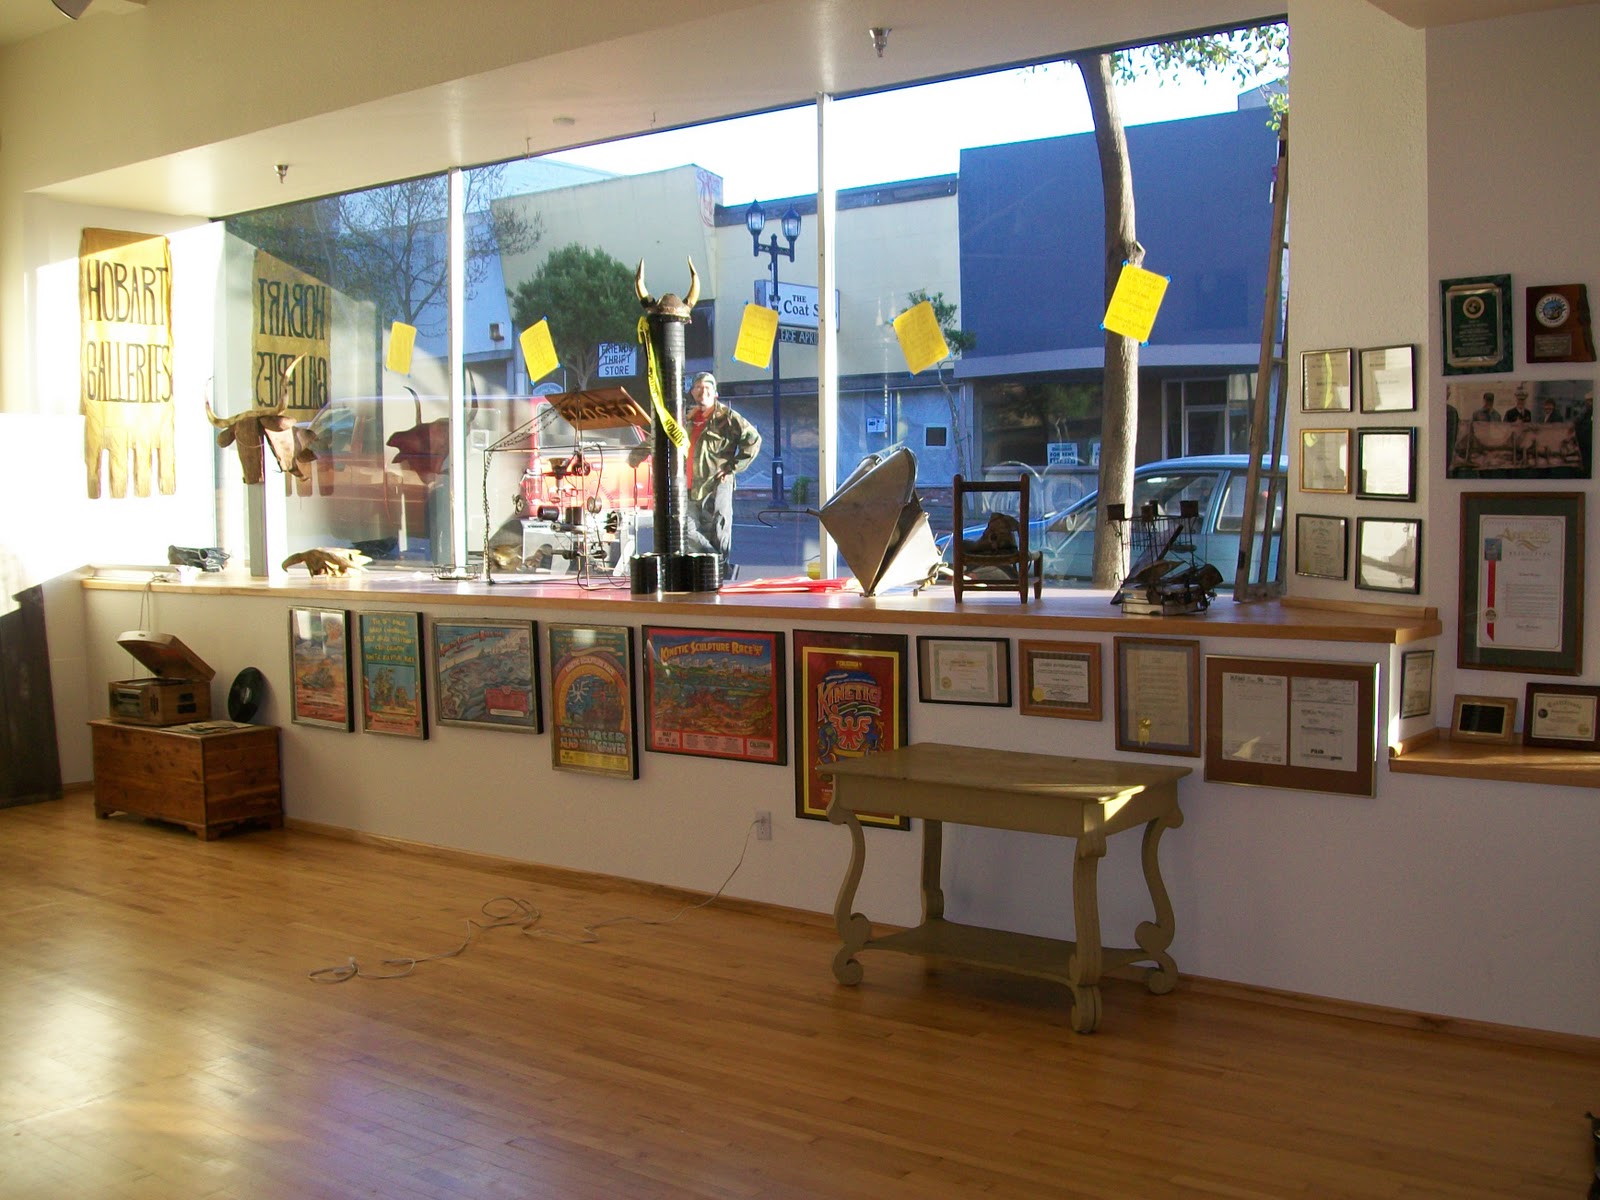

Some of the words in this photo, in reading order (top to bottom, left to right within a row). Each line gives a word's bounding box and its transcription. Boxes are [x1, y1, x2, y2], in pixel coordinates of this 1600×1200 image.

[87, 259, 168, 325] HOBART
[792, 295, 807, 303] THE
[784, 300, 809, 316] Coat
[601, 343, 633, 354] FRIENDS
[604, 355, 630, 364] THRIFT
[86, 341, 173, 403] GALLERIES
[604, 365, 629, 375] STORE
[660, 643, 689, 661] KINETIC
[690, 641, 730, 655] SCULPTURE
[731, 641, 753, 656] RACE
[817, 681, 882, 722] KINETIC
